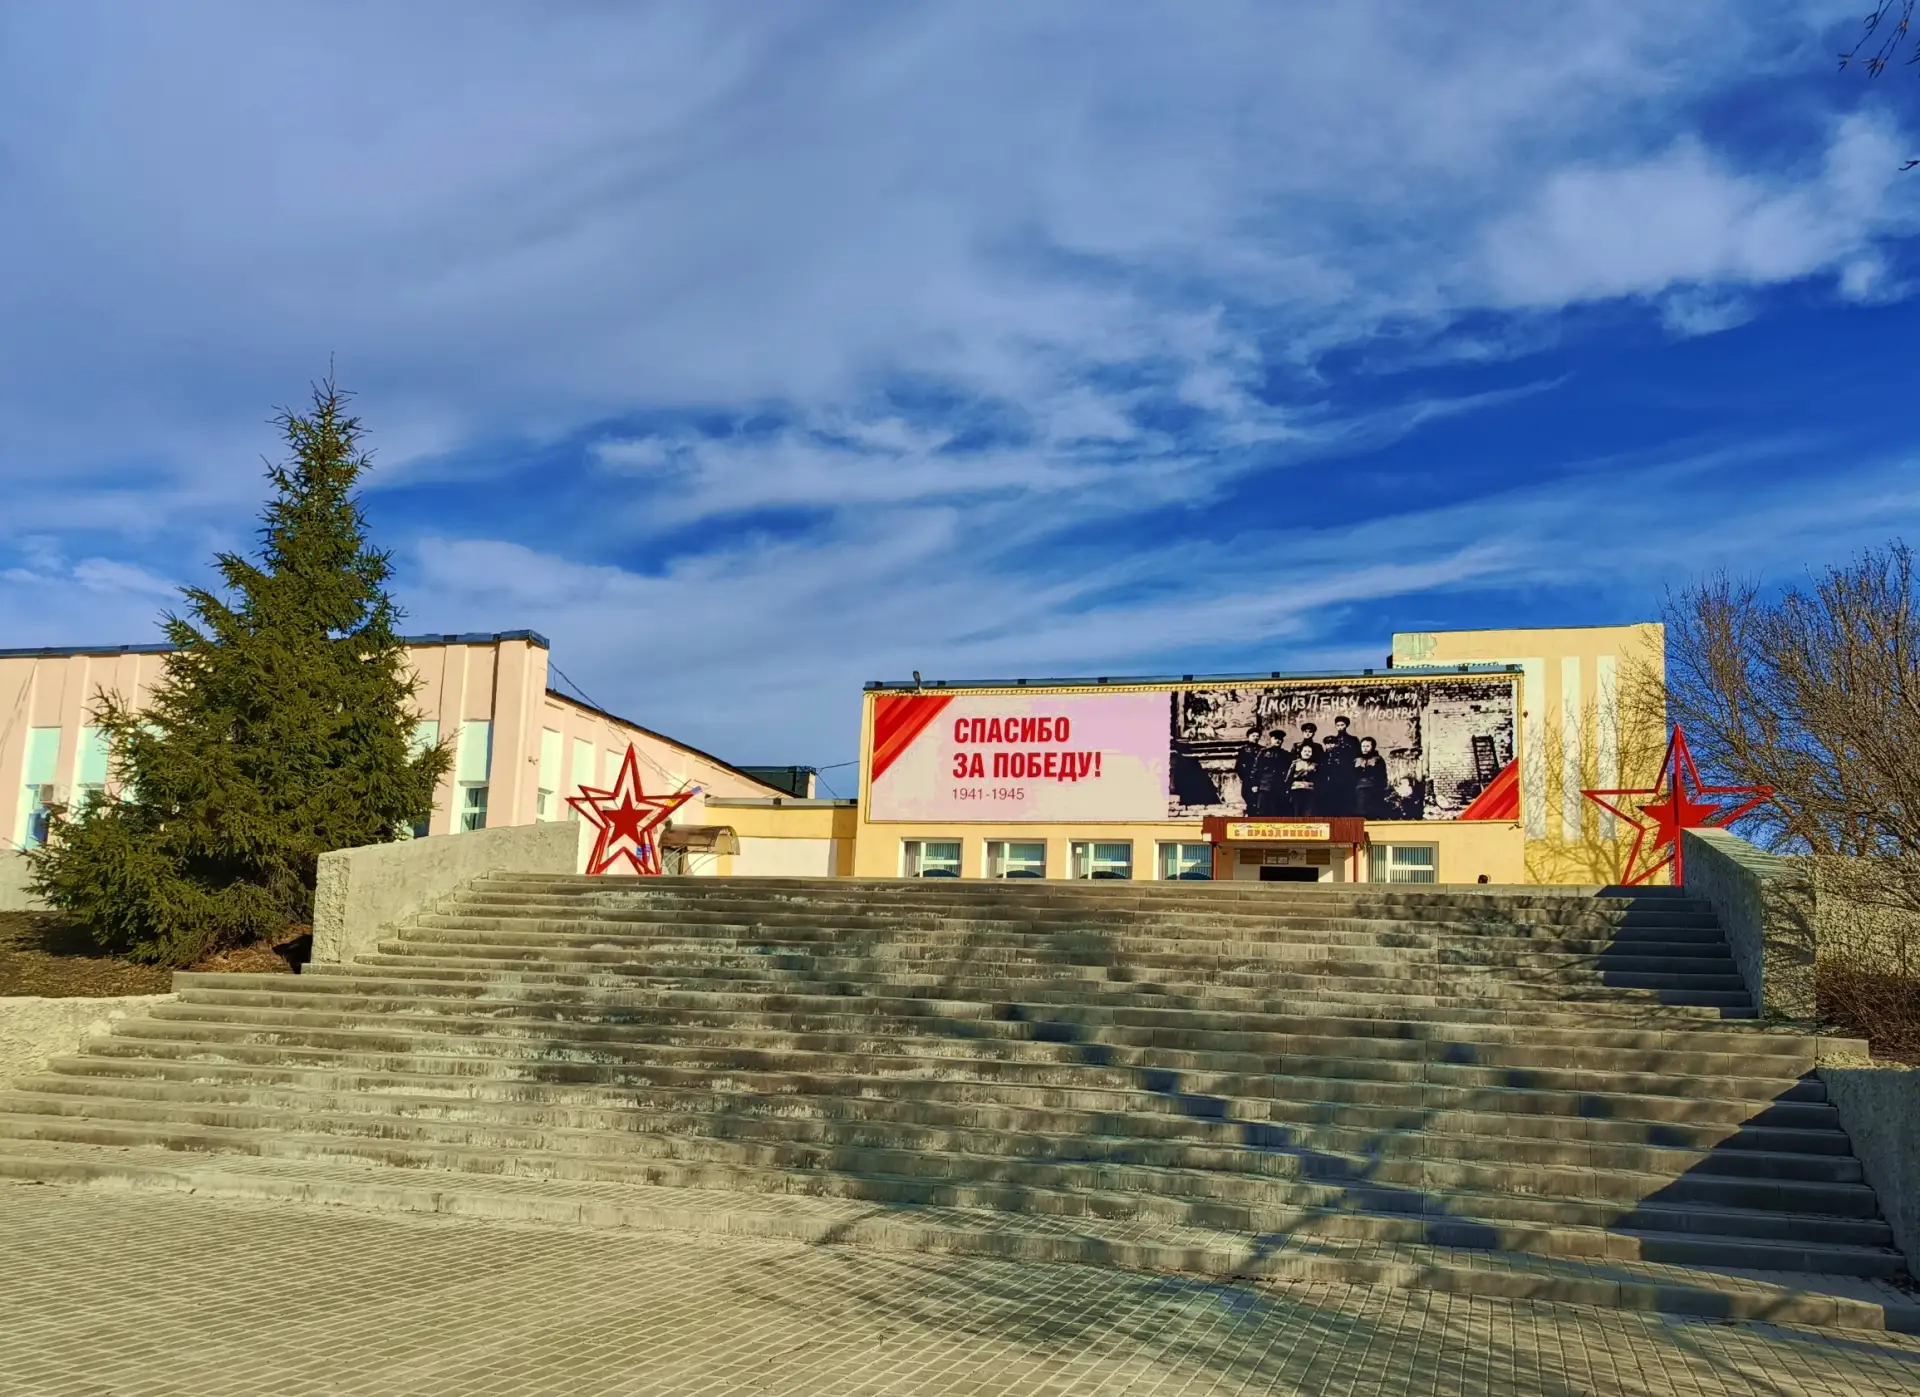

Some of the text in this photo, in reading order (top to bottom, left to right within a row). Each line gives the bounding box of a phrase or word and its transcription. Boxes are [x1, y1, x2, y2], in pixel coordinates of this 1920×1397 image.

[954, 716, 1070, 743] СПАСИБО
[953, 752, 1101, 782] ЗА ПОБЕДУ!
[952, 787, 1025, 800] 1941-1945
[1234, 829, 1240, 837] С
